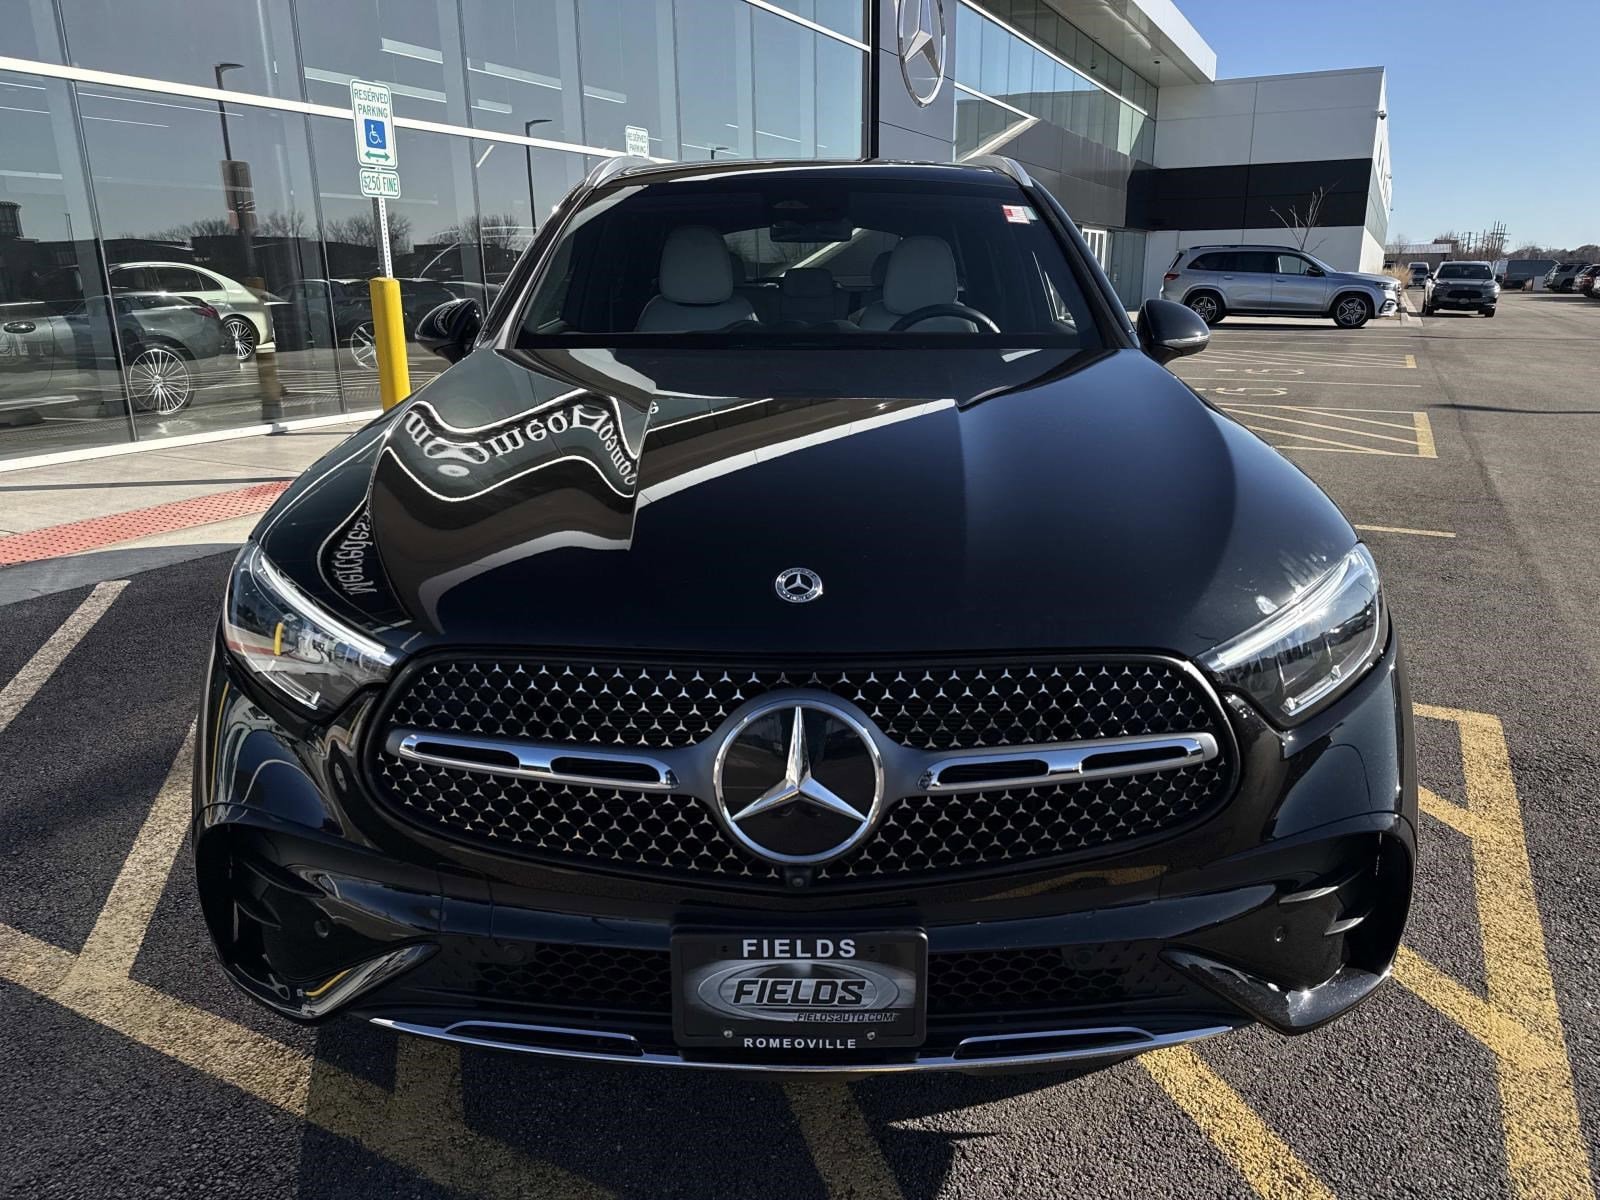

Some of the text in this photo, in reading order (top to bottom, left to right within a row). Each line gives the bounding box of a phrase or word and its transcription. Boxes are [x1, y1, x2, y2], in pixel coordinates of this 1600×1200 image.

[353, 88, 388, 104] RESERVED
[358, 104, 388, 118] PARKING
[363, 176, 398, 192] $250 FINE
[742, 939, 856, 958] FIELDS
[733, 979, 866, 1005] FIELDS
[743, 1037, 857, 1049] ROMEOVILLE
